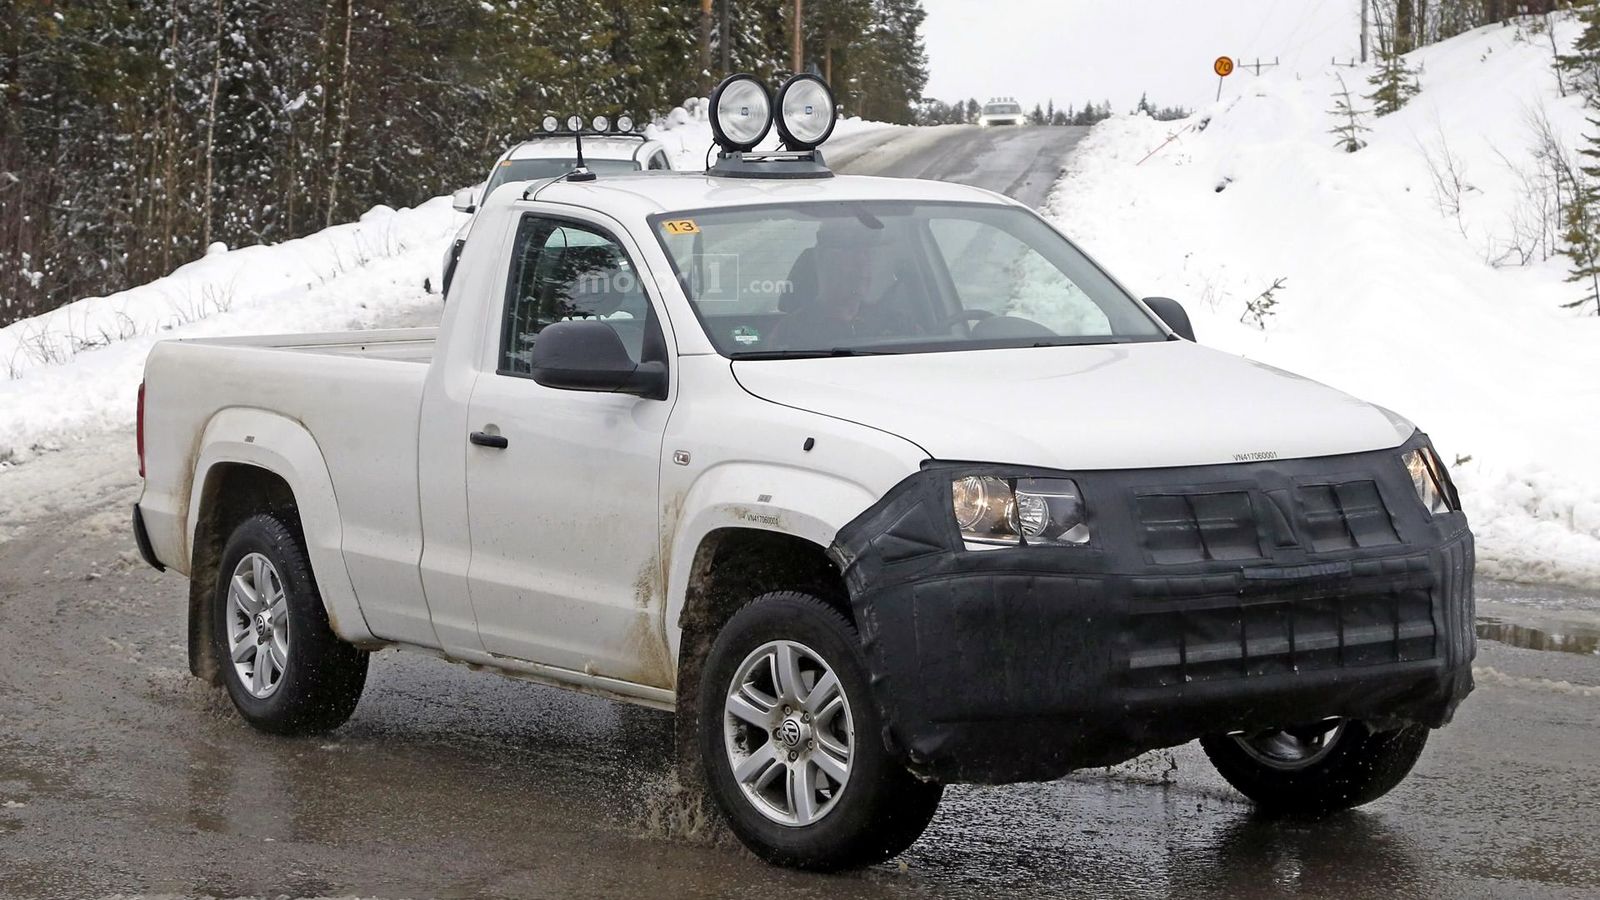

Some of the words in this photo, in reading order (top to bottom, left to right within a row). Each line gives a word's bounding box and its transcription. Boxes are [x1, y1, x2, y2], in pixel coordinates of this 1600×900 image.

[1217, 60, 1230, 71] 70
[668, 221, 694, 231] 13
[1232, 451, 1278, 461] VN417060001
